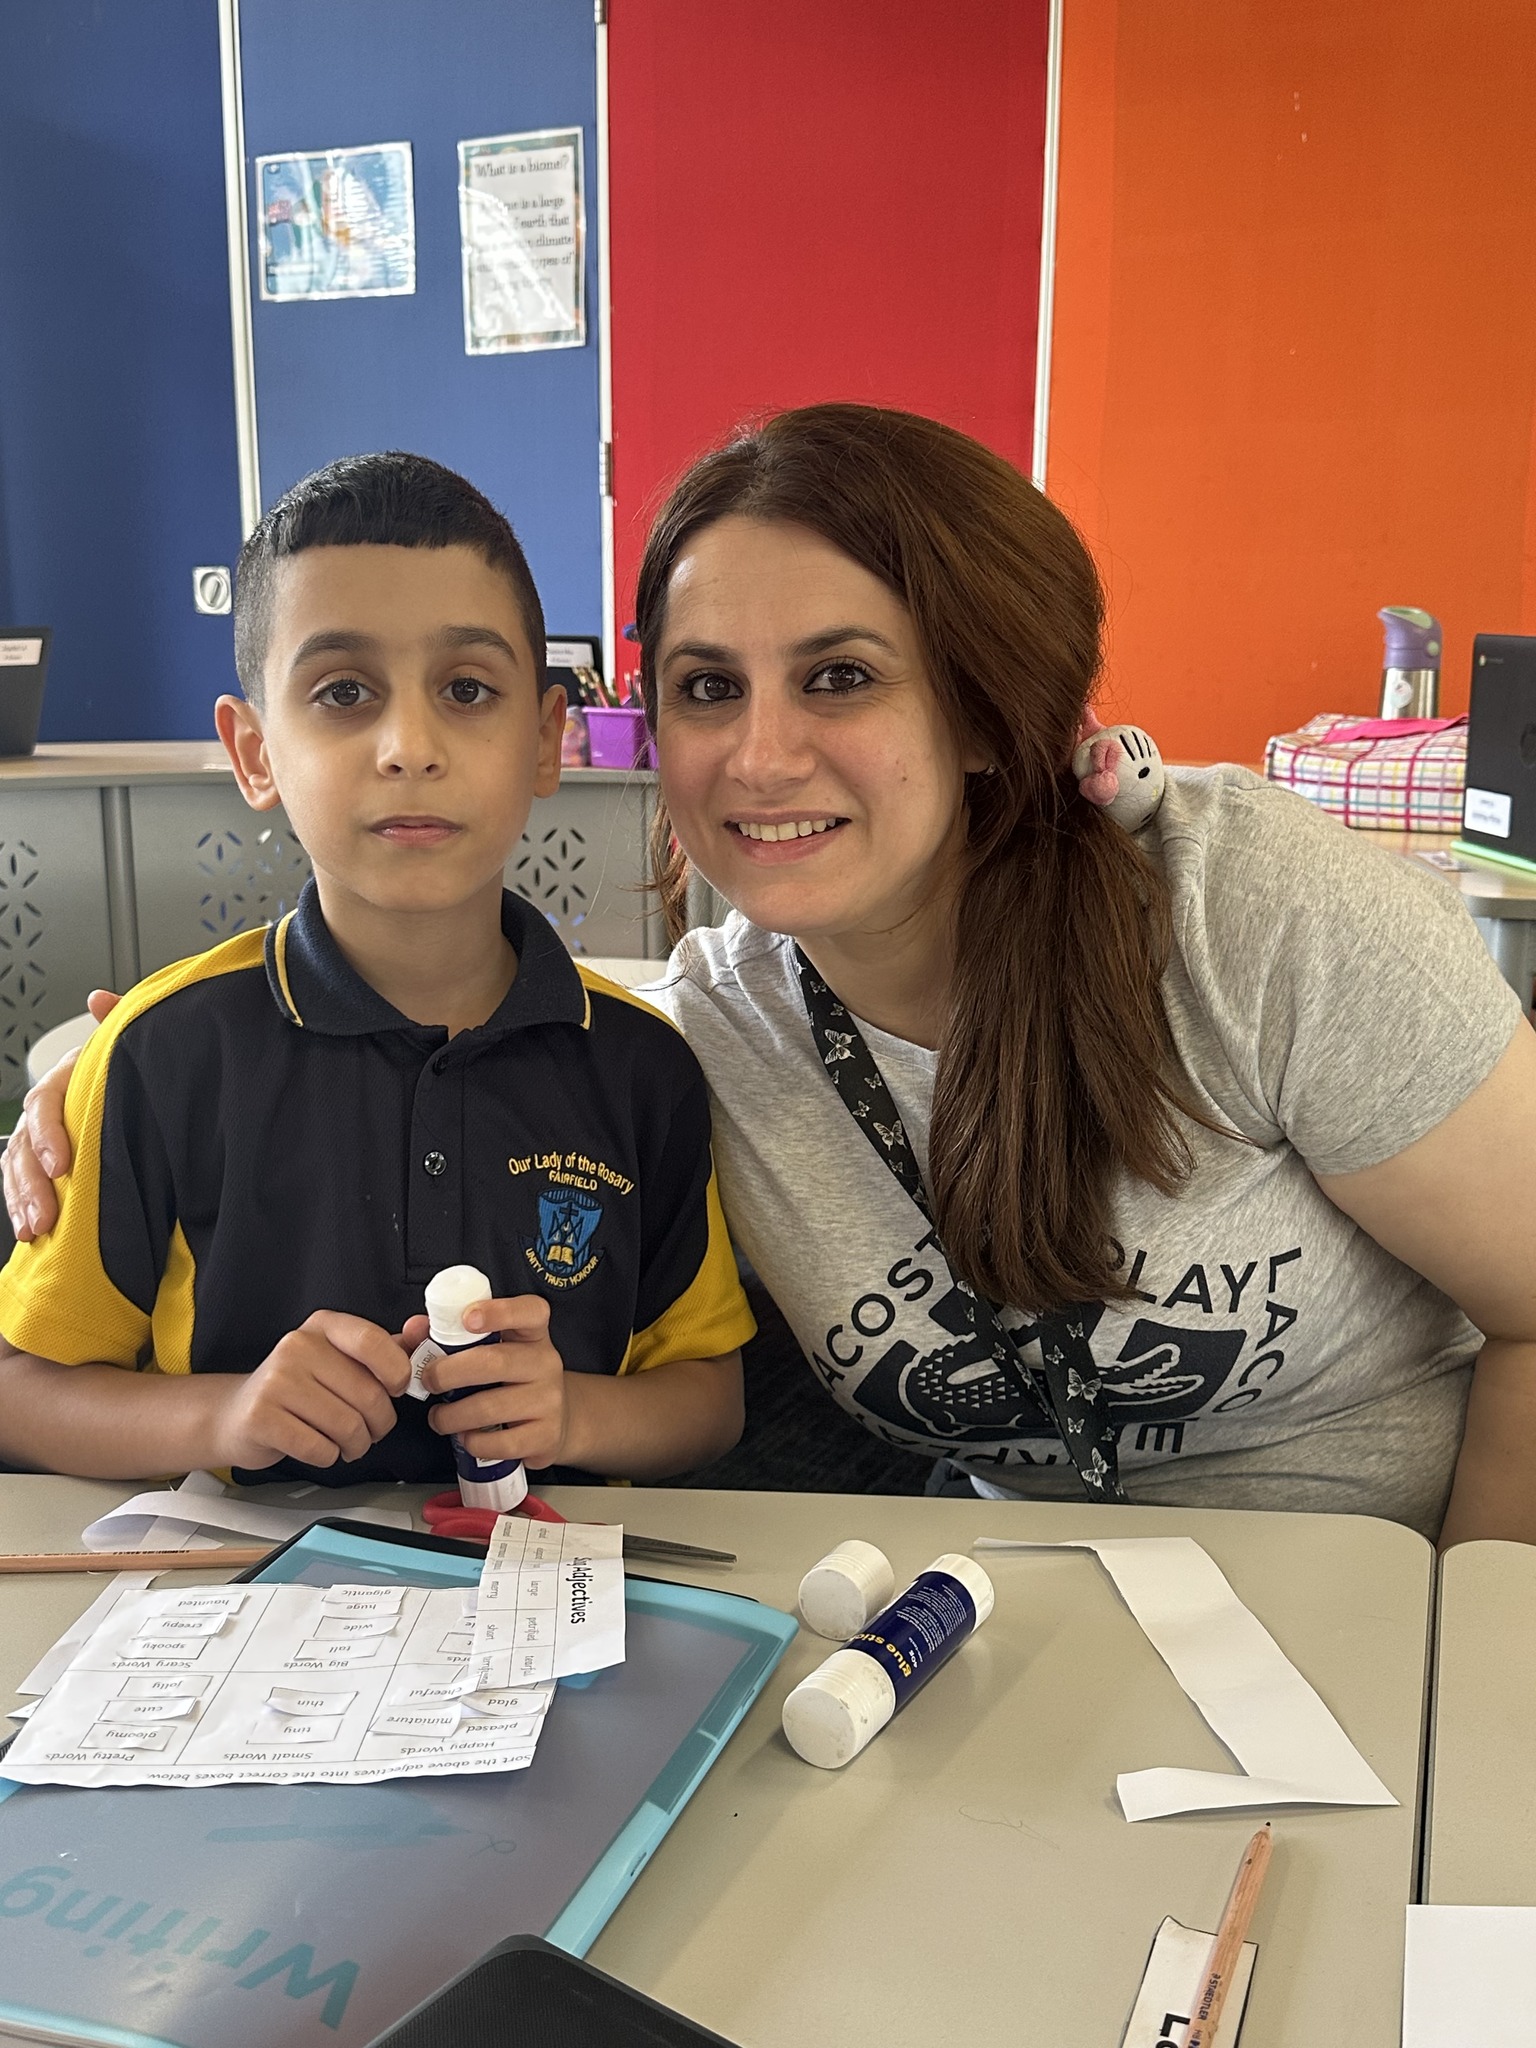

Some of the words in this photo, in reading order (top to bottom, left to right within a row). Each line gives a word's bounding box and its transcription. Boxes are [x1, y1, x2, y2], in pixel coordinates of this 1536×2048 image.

[508, 1157, 532, 1175] Our
[534, 1151, 563, 1171] Lady
[565, 1152, 577, 1168] of
[577, 1154, 598, 1175] the
[597, 1162, 635, 1195] Rosary
[548, 1169, 598, 1191] FAIRFIELD
[525, 1247, 545, 1273] UNITY
[544, 1271, 568, 1287] TRUST
[569, 1255, 599, 1286] HONOUR
[811, 1227, 942, 1393] ACOST
[342, 1589, 392, 1597] gigantic
[487, 1580, 500, 1599] merry
[527, 1580, 541, 1597] large
[566, 1566, 593, 1624] Adjectives
[177, 1599, 230, 1607] haunted
[161, 1620, 203, 1629] creepy
[343, 1623, 373, 1631] wide
[485, 1624, 499, 1641] short
[849, 1633, 885, 1645] stic
[142, 1642, 187, 1650] spooky
[328, 1645, 352, 1653] tall
[446, 1655, 471, 1663] ords
[886, 1643, 912, 1677] glue
[111, 1660, 151, 1669] Words
[155, 1660, 193, 1669] Scary
[283, 1660, 323, 1669] Words
[328, 1660, 349, 1668] Big
[152, 1680, 183, 1690] jolly
[409, 1686, 463, 1697] cheerful
[297, 1700, 324, 1708] thin
[487, 1698, 518, 1707] glad
[386, 1716, 453, 1724] miniature
[283, 1726, 311, 1734] tiny
[466, 1722, 518, 1733] pleased
[105, 1730, 157, 1739] gloomy
[400, 1744, 444, 1755] Words
[449, 1741, 495, 1750] Happy
[43, 1752, 87, 1761] Words
[92, 1752, 136, 1761] Pretty
[223, 1752, 267, 1761] Words
[270, 1752, 313, 1760] Small
[497, 1754, 532, 1763] Sort
[428, 1761, 470, 1770] above
[475, 1758, 497, 1767] the
[320, 1770, 349, 1778] into
[353, 1763, 425, 1777] adjectives
[194, 1772, 234, 1780] boxes
[239, 1771, 289, 1779] correct
[292, 1771, 315, 1779] the
[0, 1866, 361, 2030] Writing
[1198, 1978, 1218, 2021] STAEDTLER
